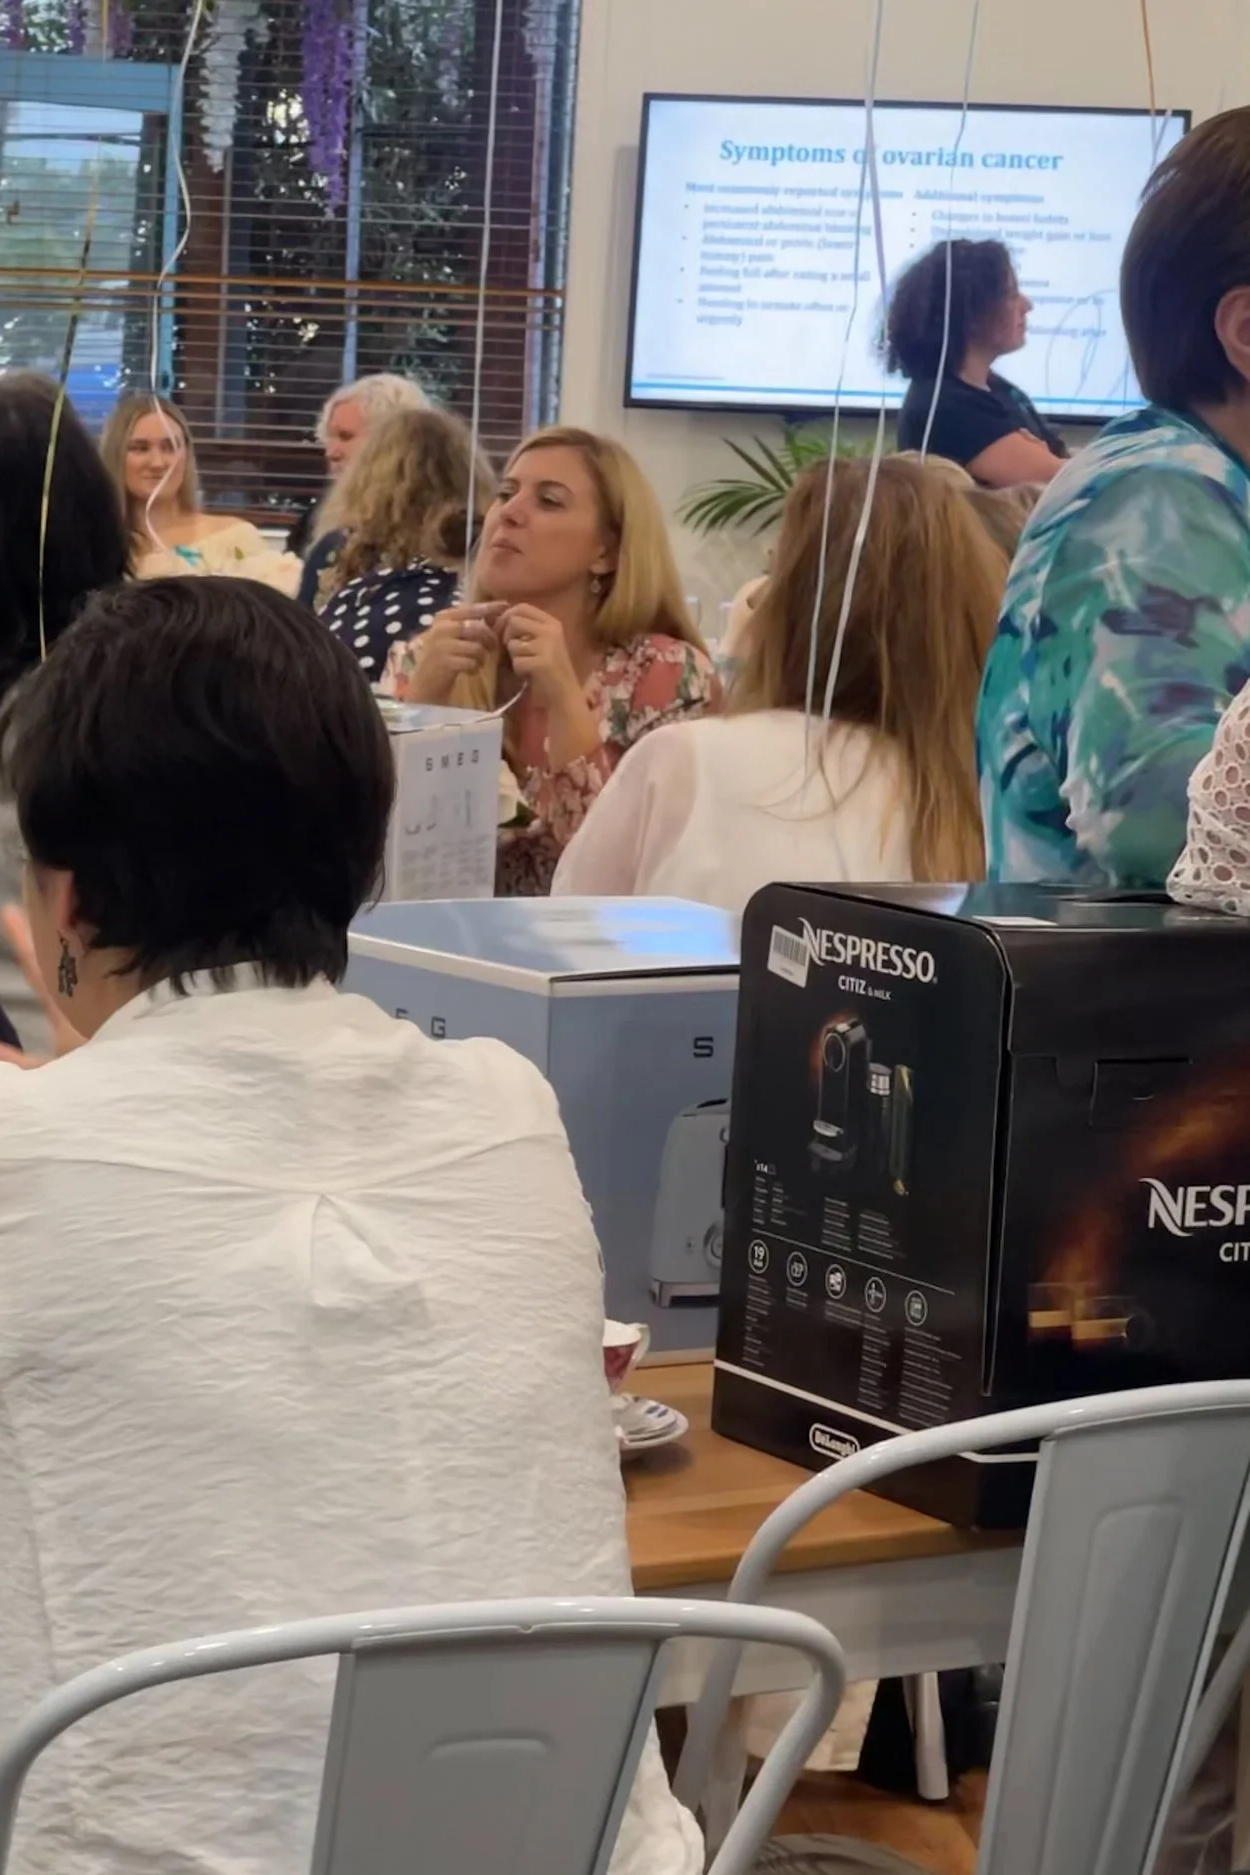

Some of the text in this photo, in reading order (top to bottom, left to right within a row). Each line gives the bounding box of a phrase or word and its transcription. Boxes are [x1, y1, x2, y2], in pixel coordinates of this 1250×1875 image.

[719, 140, 846, 166] Symptoms
[882, 147, 974, 168] ovarian
[981, 151, 1064, 170] cancer
[798, 917, 935, 984] NESPRESSO
[837, 975, 867, 996] CITIZ
